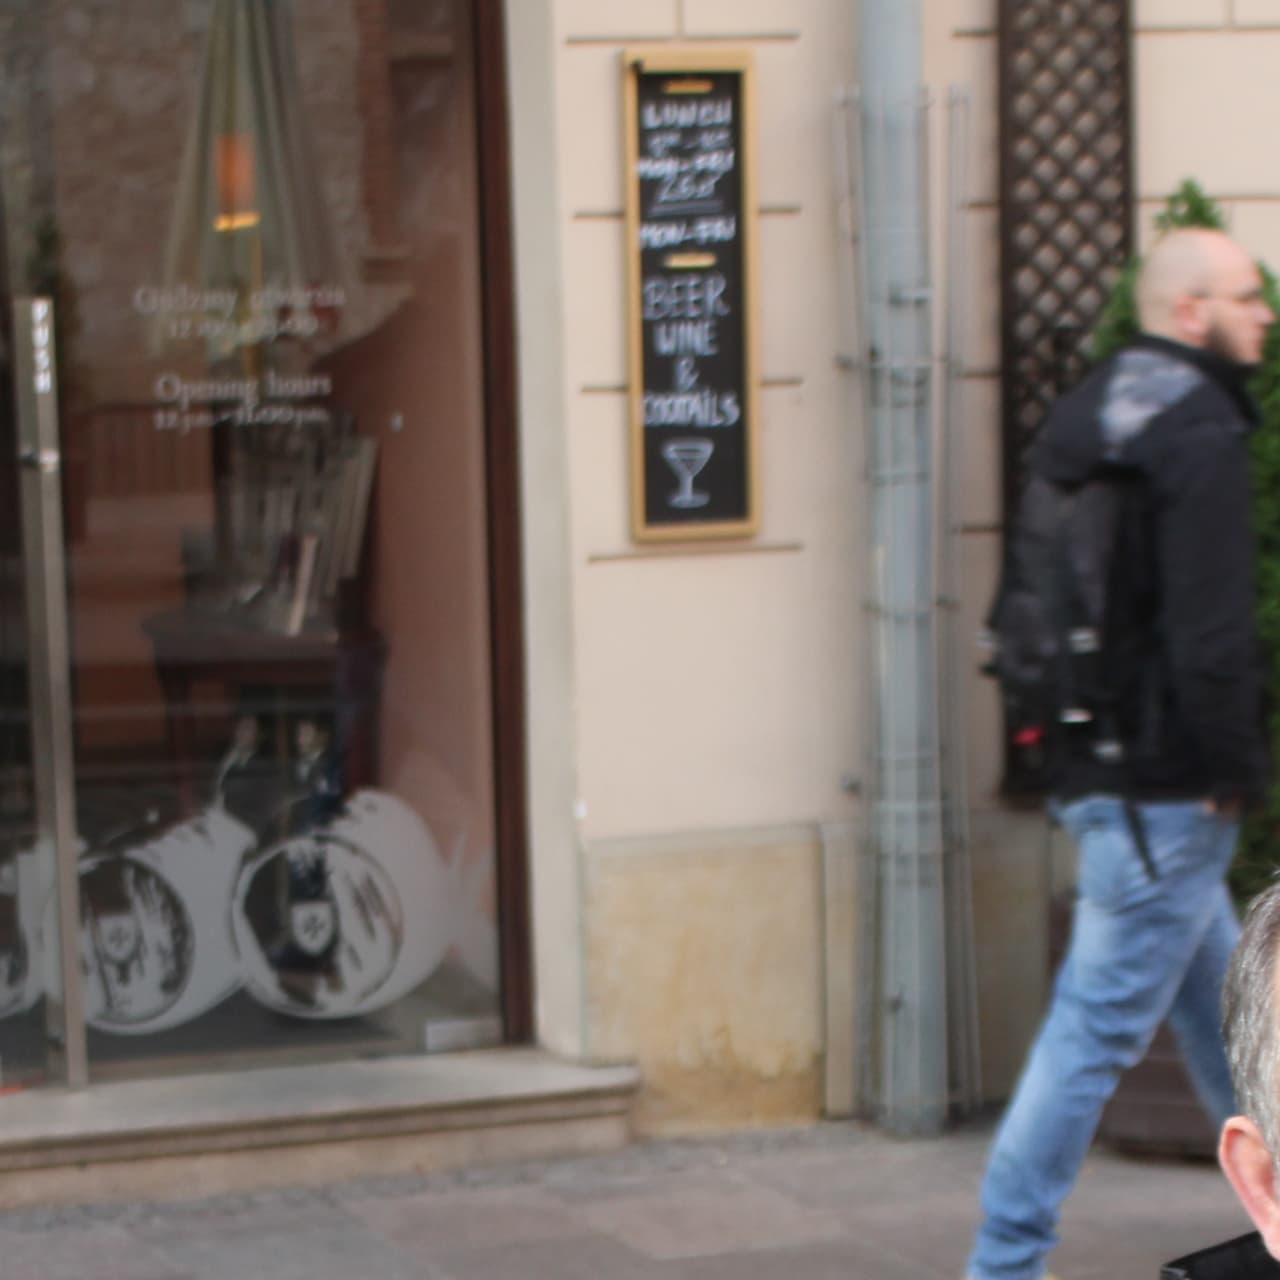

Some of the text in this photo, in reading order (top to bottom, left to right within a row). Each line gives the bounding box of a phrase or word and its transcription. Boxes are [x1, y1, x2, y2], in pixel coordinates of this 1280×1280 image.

[644, 274, 730, 320] BEER
[654, 320, 720, 357] WINE
[154, 368, 333, 411] Opening hours
